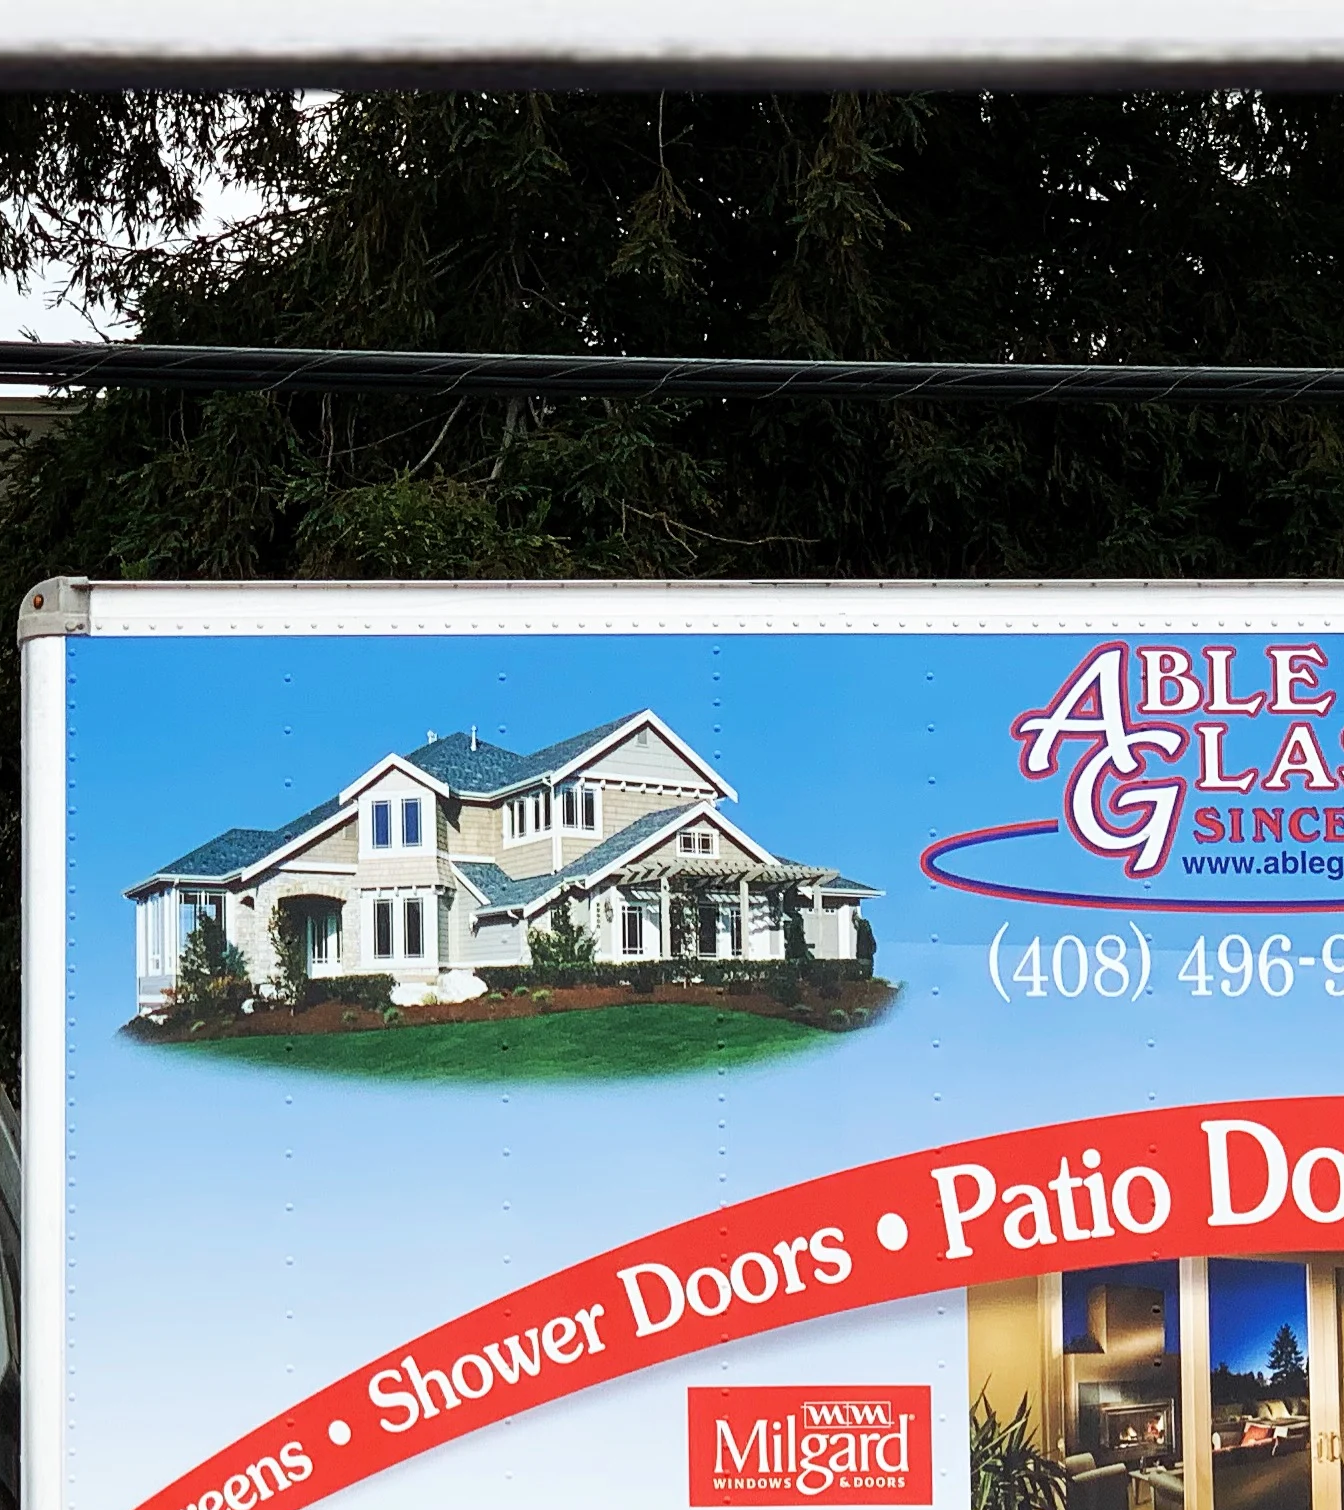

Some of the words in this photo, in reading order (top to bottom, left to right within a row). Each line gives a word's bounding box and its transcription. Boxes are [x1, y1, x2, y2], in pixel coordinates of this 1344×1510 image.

[1011, 640, 1337, 778] ABLE
[989, 921, 1152, 1004] (408)
[931, 1148, 1171, 1260] Patio
[367, 1303, 607, 1434] Shower
[616, 1226, 854, 1338] Doors
[713, 1413, 910, 1496] Milgard
[713, 1477, 792, 1490] WINDOWS
[839, 1476, 851, 1488] &
[853, 1476, 906, 1489] DOORS
